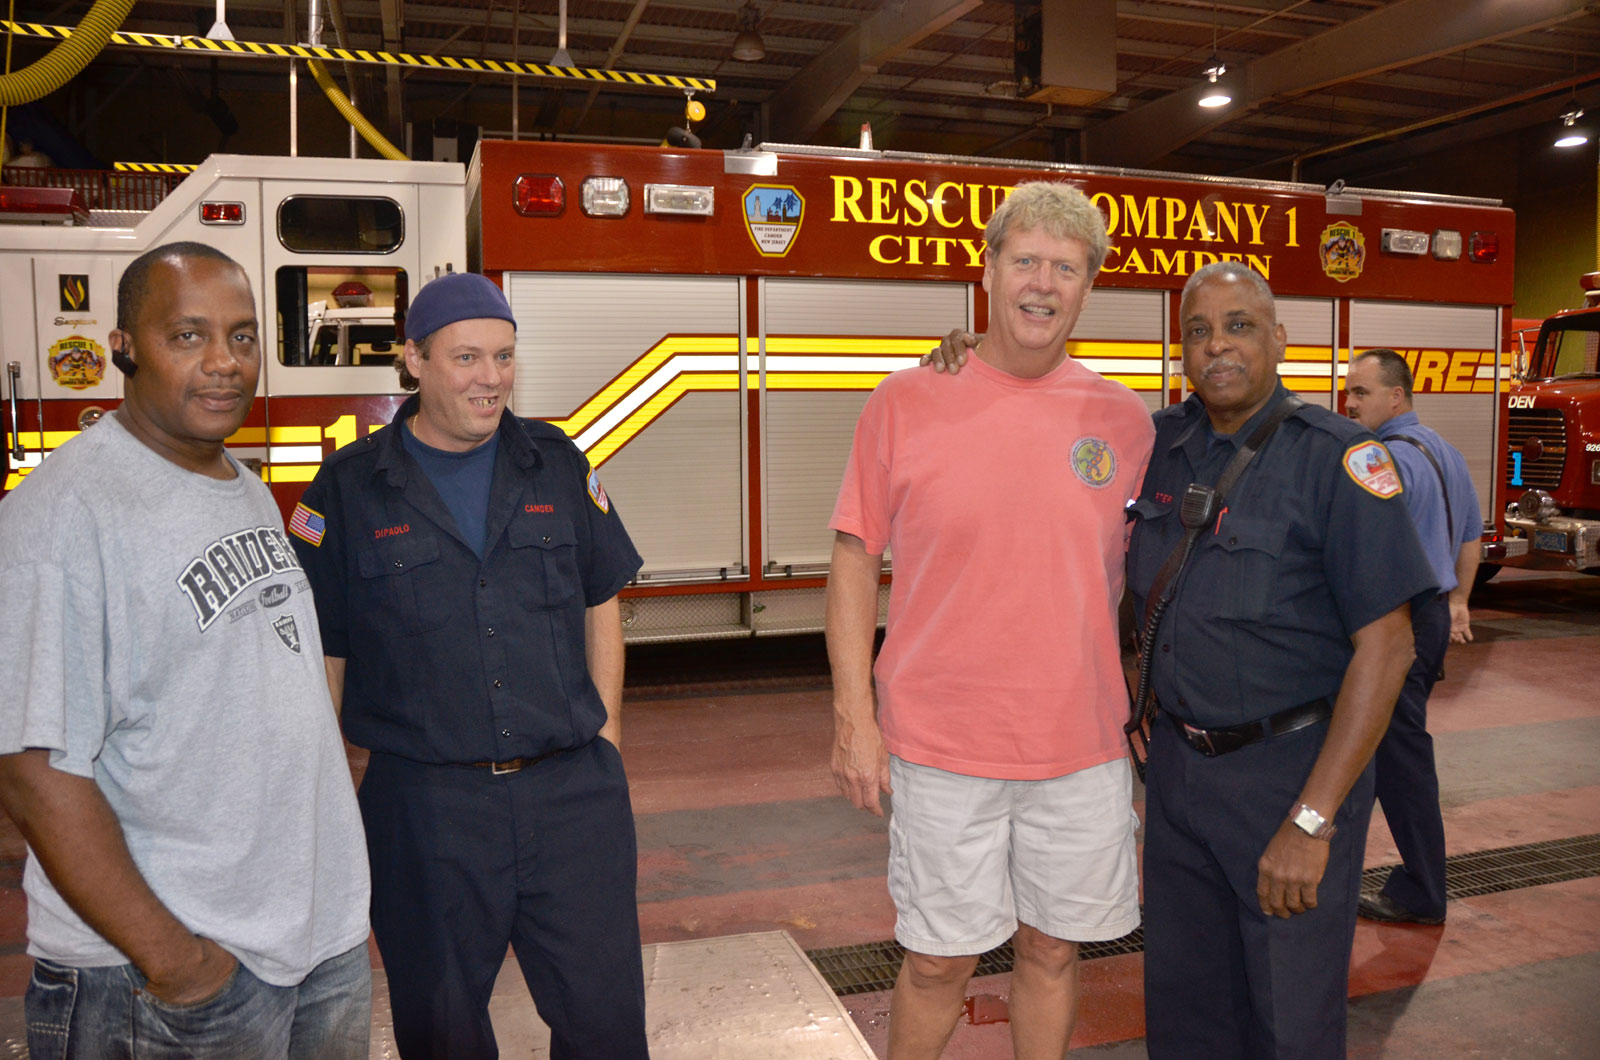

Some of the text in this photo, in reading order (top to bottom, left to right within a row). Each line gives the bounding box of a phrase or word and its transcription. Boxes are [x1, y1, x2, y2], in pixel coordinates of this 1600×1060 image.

[829, 175, 1300, 247] RESCU OMPANY 1
[868, 234, 988, 267] CITY
[60, 341, 86, 350] RESCUE
[1394, 350, 1481, 392] IRE
[524, 504, 554, 513] CAMDEN
[375, 524, 410, 539] DIPAOLO
[176, 526, 304, 634] RAIDER
